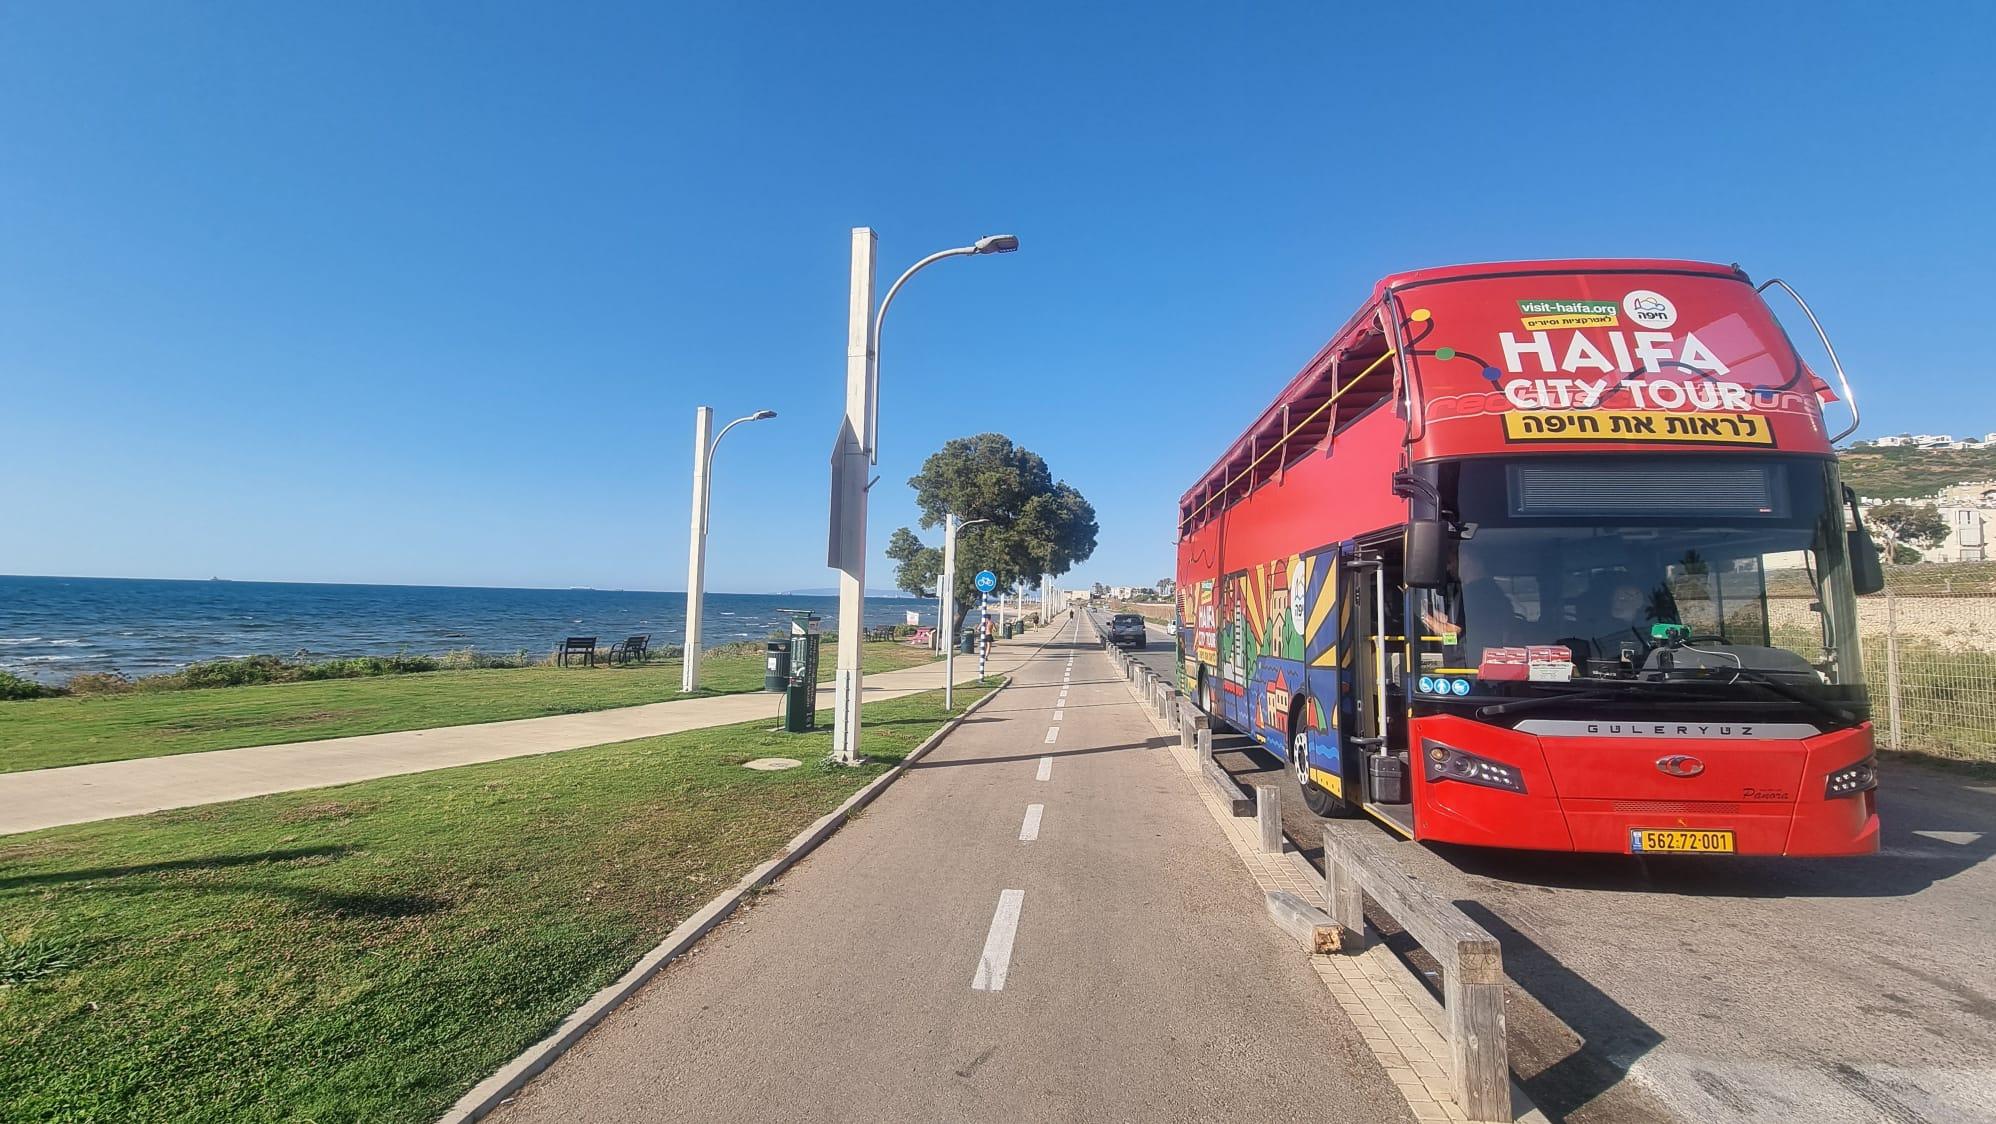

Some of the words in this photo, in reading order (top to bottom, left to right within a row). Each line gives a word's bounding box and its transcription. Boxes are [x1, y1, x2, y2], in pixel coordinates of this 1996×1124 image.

[1521, 302, 1617, 316] visit-haifa.org
[1637, 311, 1668, 320] חיפה
[1499, 330, 1731, 376] HAIFA
[1504, 379, 1607, 408] CITY
[1621, 379, 1751, 411] TOUR
[1522, 414, 1600, 434] חיפה
[1609, 414, 1655, 434] את
[1665, 414, 1756, 437] לראות
